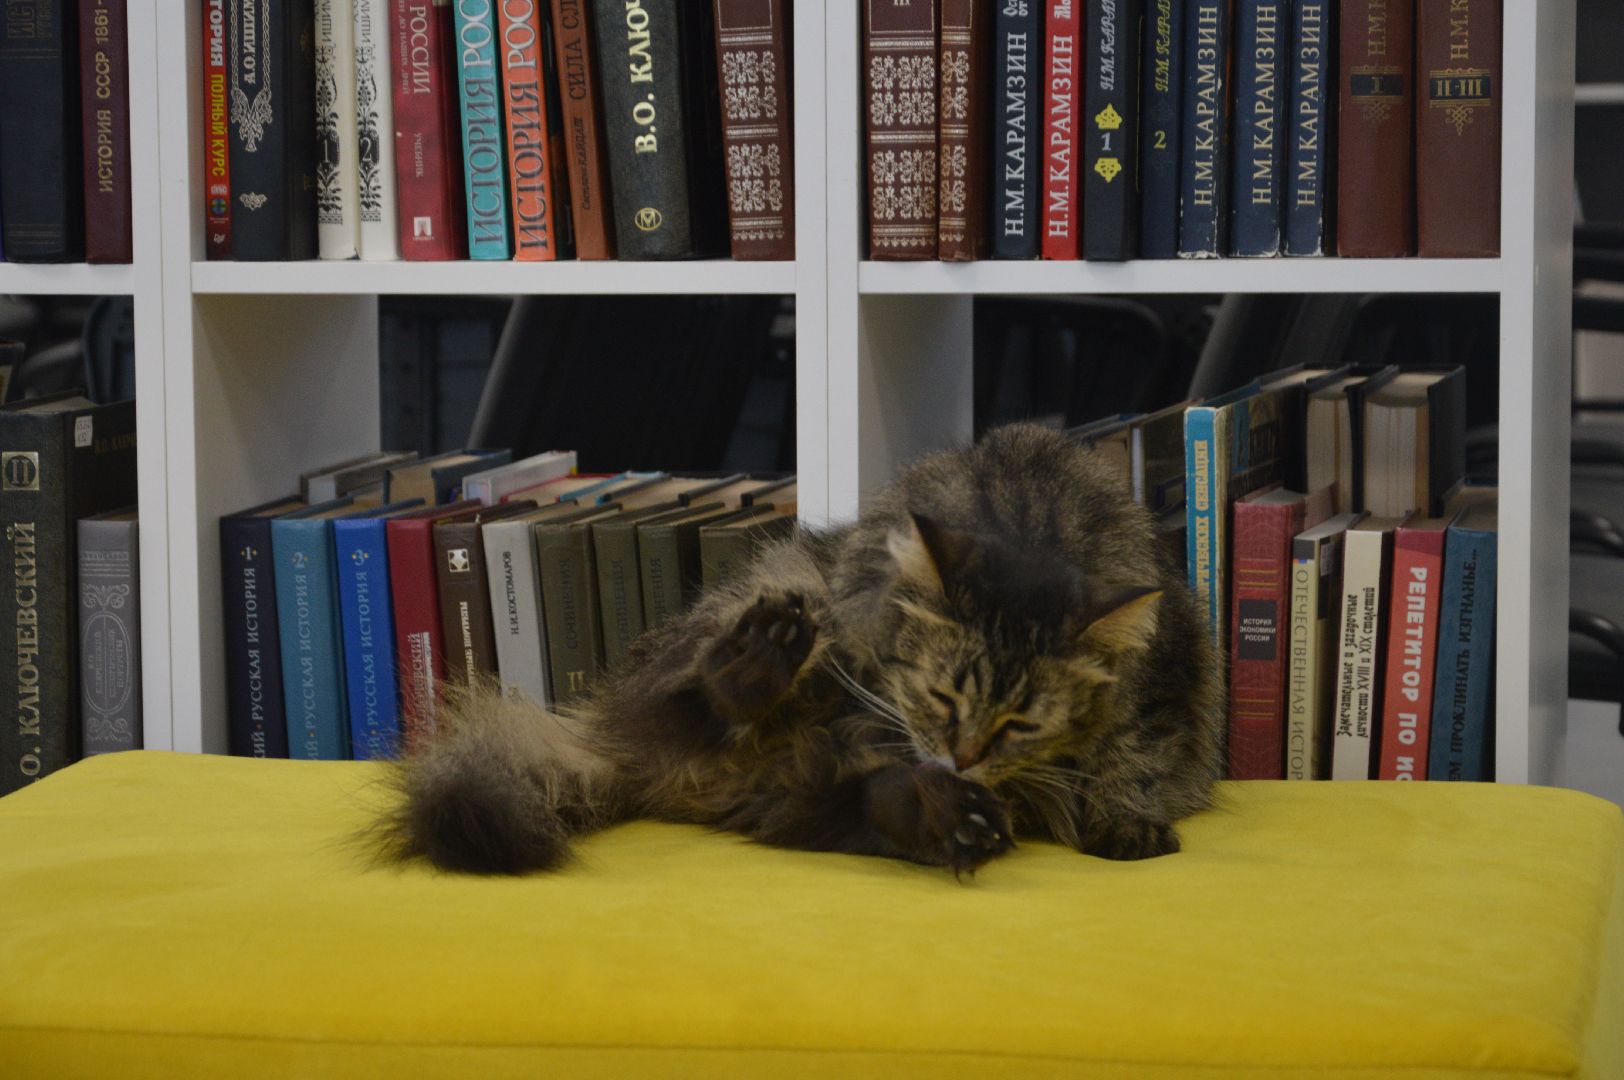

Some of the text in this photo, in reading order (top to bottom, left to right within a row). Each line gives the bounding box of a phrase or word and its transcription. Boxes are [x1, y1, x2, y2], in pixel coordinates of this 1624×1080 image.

[95, 51, 111, 99] СССР
[410, 5, 432, 95] РОССИИ
[567, 37, 591, 100] СИЛА
[210, 74, 228, 135] ПОЛНЫЙ
[632, 93, 658, 154] В.О.
[98, 109, 113, 192] ИСТОРИЯ
[211, 138, 227, 177] КУРС
[359, 137, 372, 161] 2
[464, 78, 504, 247] ИСТОРИЯ
[509, 80, 548, 251] ИСТОРИЯ
[1101, 132, 1111, 150] 1
[1153, 131, 1167, 149] 2
[353, 549, 365, 566] 3
[7, 522, 41, 736] КЛЮЧЕВСКИЙ
[243, 567, 259, 643] ИСТОРИЯ
[295, 573, 311, 651] ИСТОРИЯ
[355, 571, 372, 647] ИСТОРИЯ
[1239, 626, 1276, 634] ЭКОНОМИКИ
[1344, 594, 1358, 648] загадочные
[1361, 587, 1376, 635] столетий
[1401, 566, 1428, 702] РЕПЕТИТОР
[1244, 634, 1270, 642] РОССИИ
[1292, 569, 1309, 715] ОТЕЧЕСТВЕННАЯ
[1359, 636, 1372, 655] XIX
[248, 649, 264, 721] РУССКАЯ
[299, 656, 316, 730] РУССКАЯ
[360, 653, 378, 726] РУССКАЯ
[1336, 661, 1354, 737] Замечательные
[1357, 665, 1370, 691] XVIII
[1450, 651, 1471, 755] ПРОКЛИНАТЬ
[1356, 692, 1369, 738] личности
[1398, 712, 1417, 745] ПО
